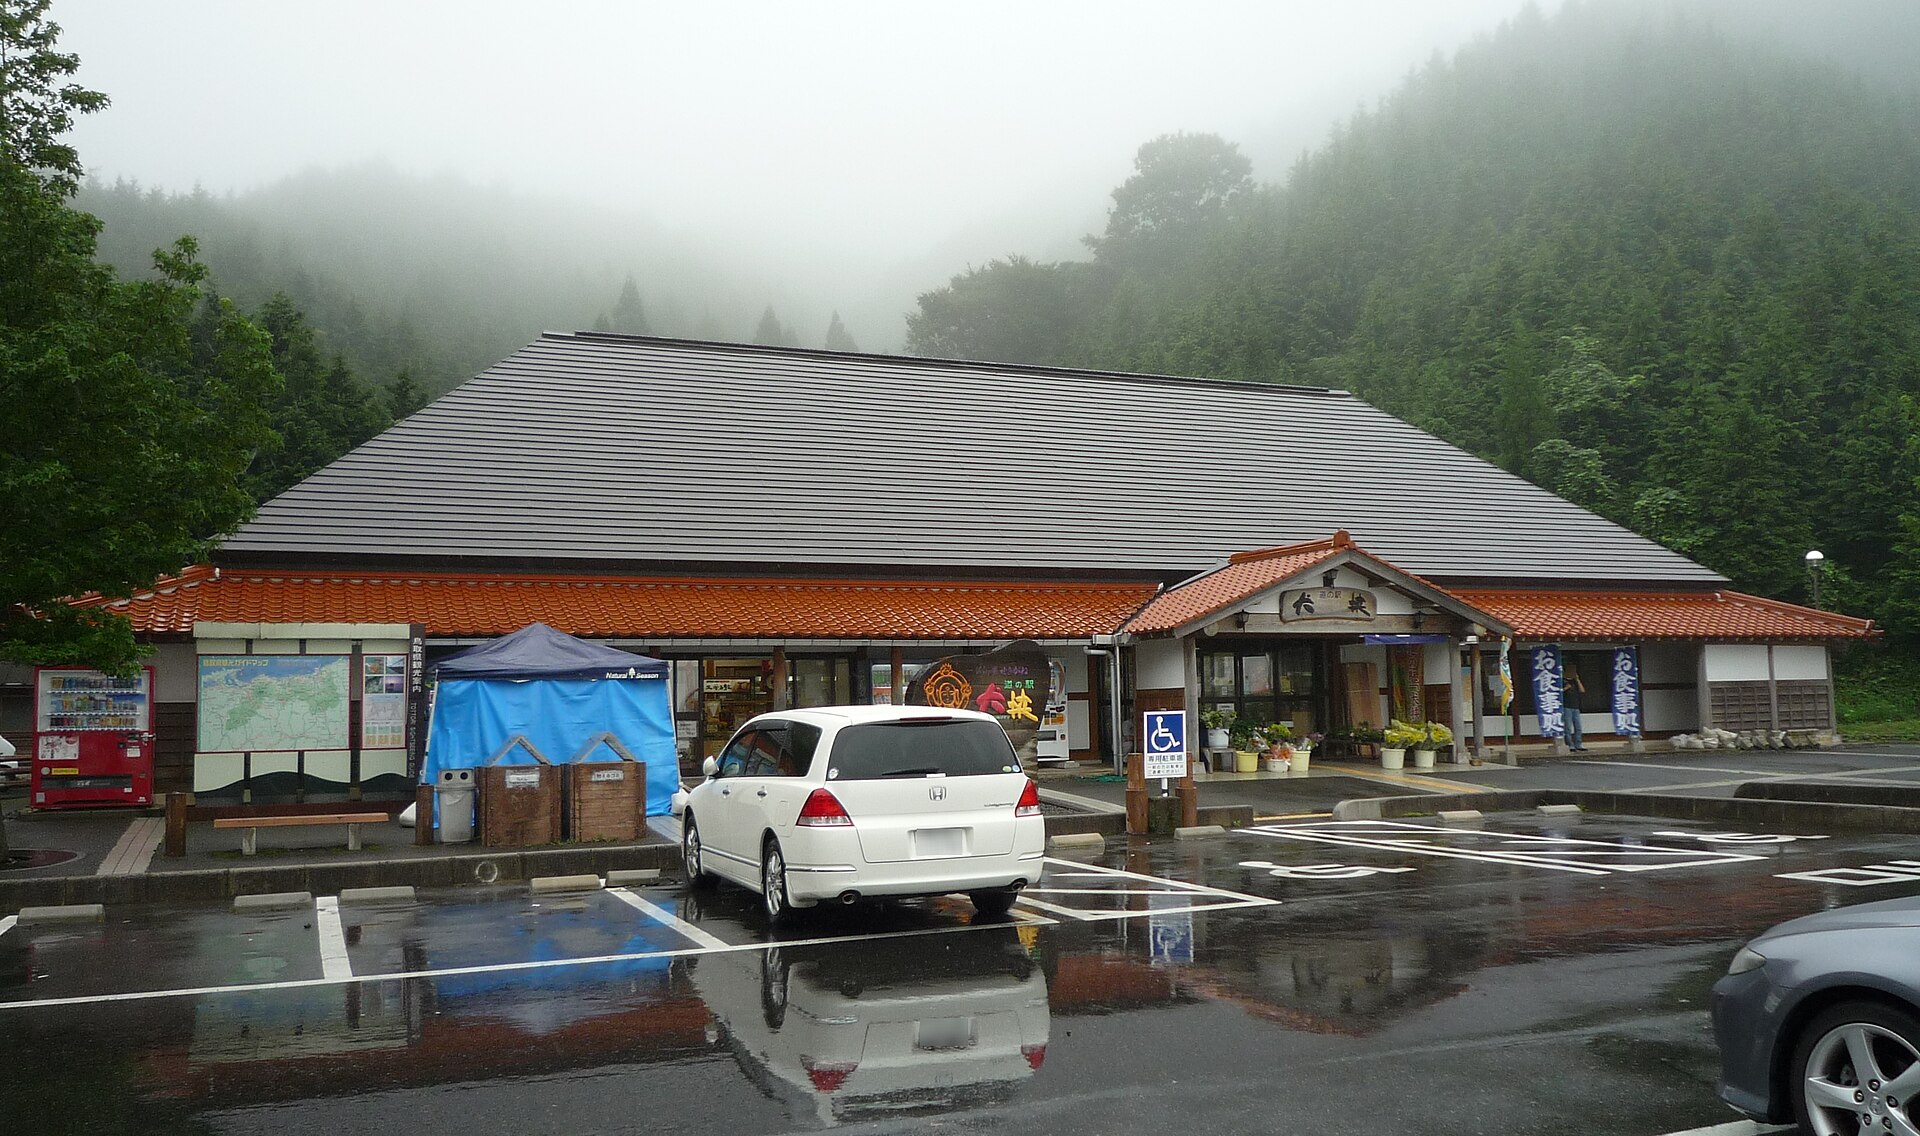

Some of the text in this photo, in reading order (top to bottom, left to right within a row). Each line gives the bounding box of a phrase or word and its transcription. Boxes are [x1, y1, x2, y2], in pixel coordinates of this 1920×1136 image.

[1319, 591, 1342, 599] 道の駅
[412, 637, 423, 693] 鳥取県観光案内
[1004, 680, 1034, 689] 道の駅
[1533, 650, 1565, 732] お食事処
[1613, 652, 1640, 733] お食事処
[1148, 755, 1183, 763] 専用駐車場
